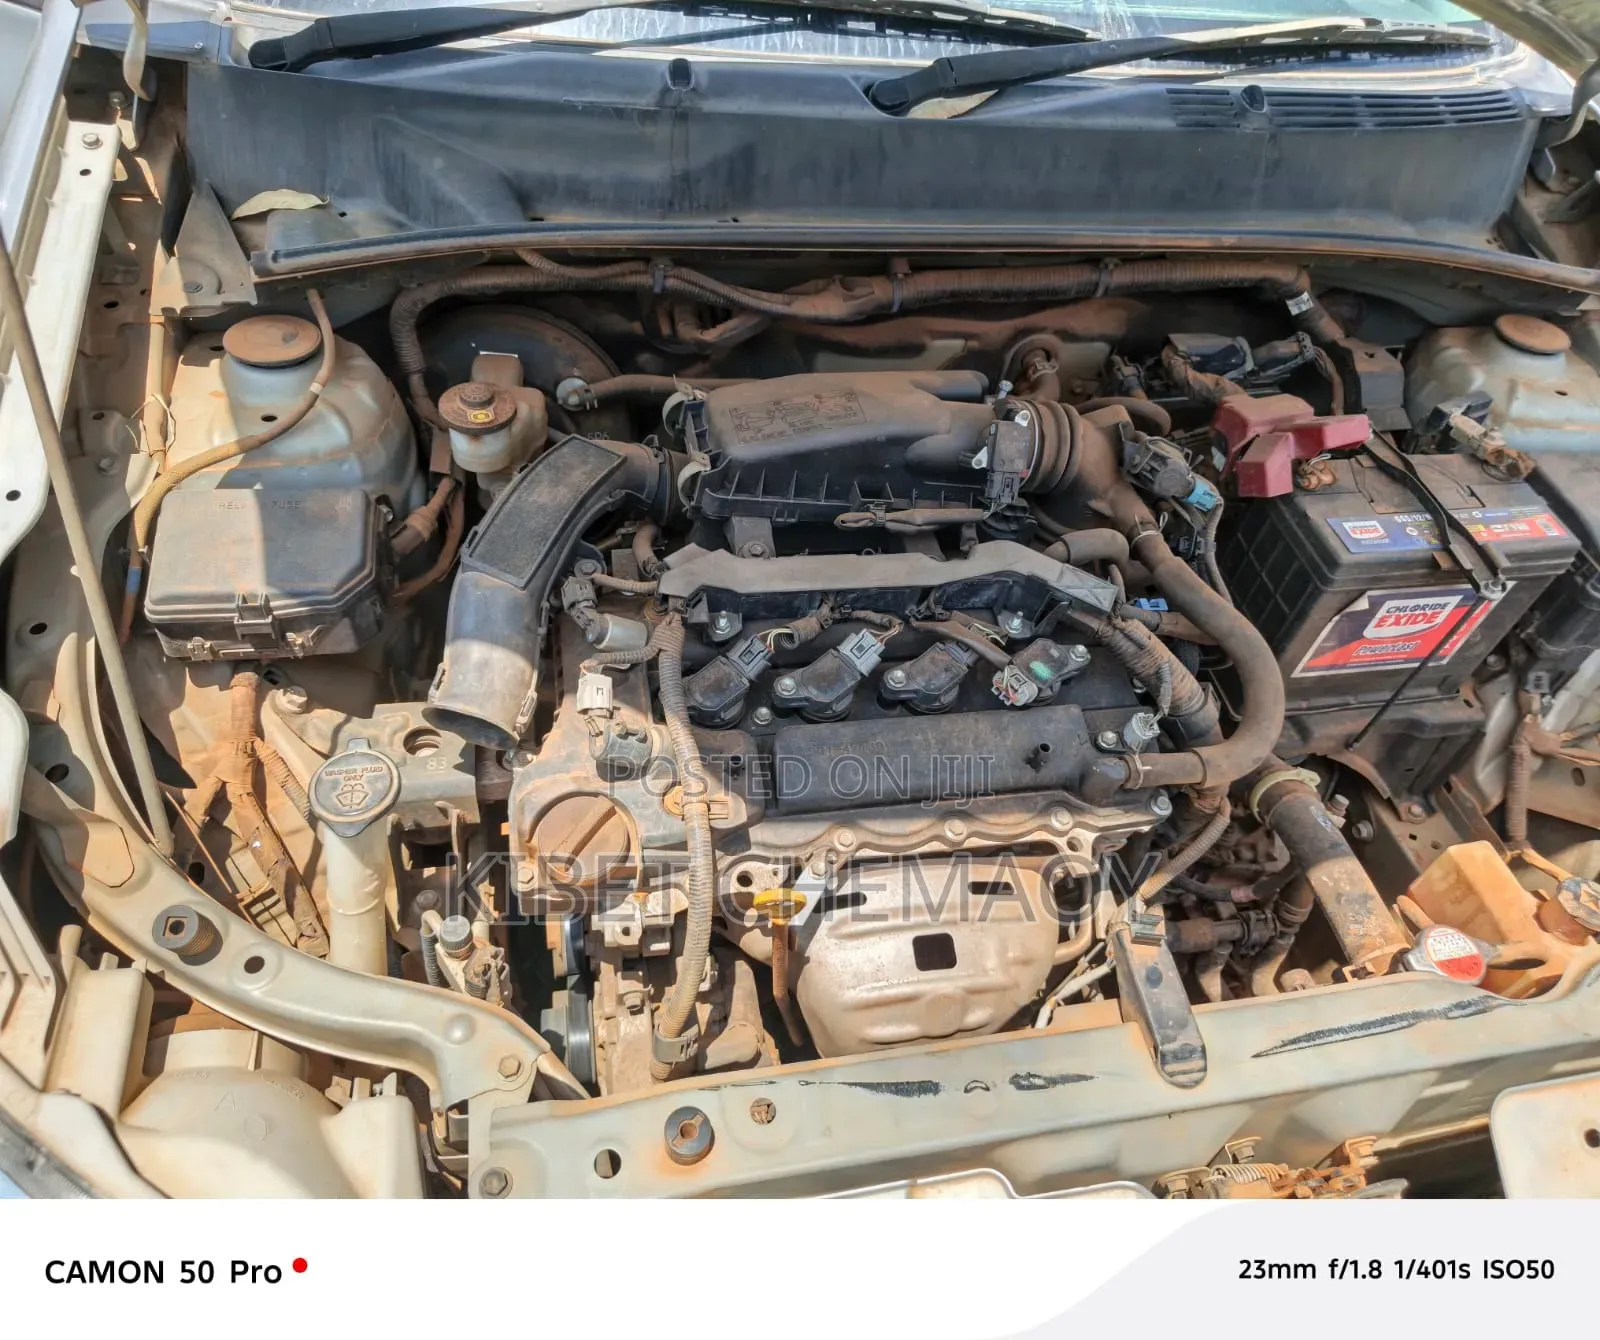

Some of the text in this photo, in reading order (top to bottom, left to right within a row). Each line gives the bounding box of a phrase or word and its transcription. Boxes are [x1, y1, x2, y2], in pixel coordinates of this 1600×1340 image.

[1385, 602, 1451, 614] CHLORIDE
[1373, 611, 1445, 629] EXIDE
[426, 757, 448, 770] 83
[343, 773, 364, 781] ONLY
